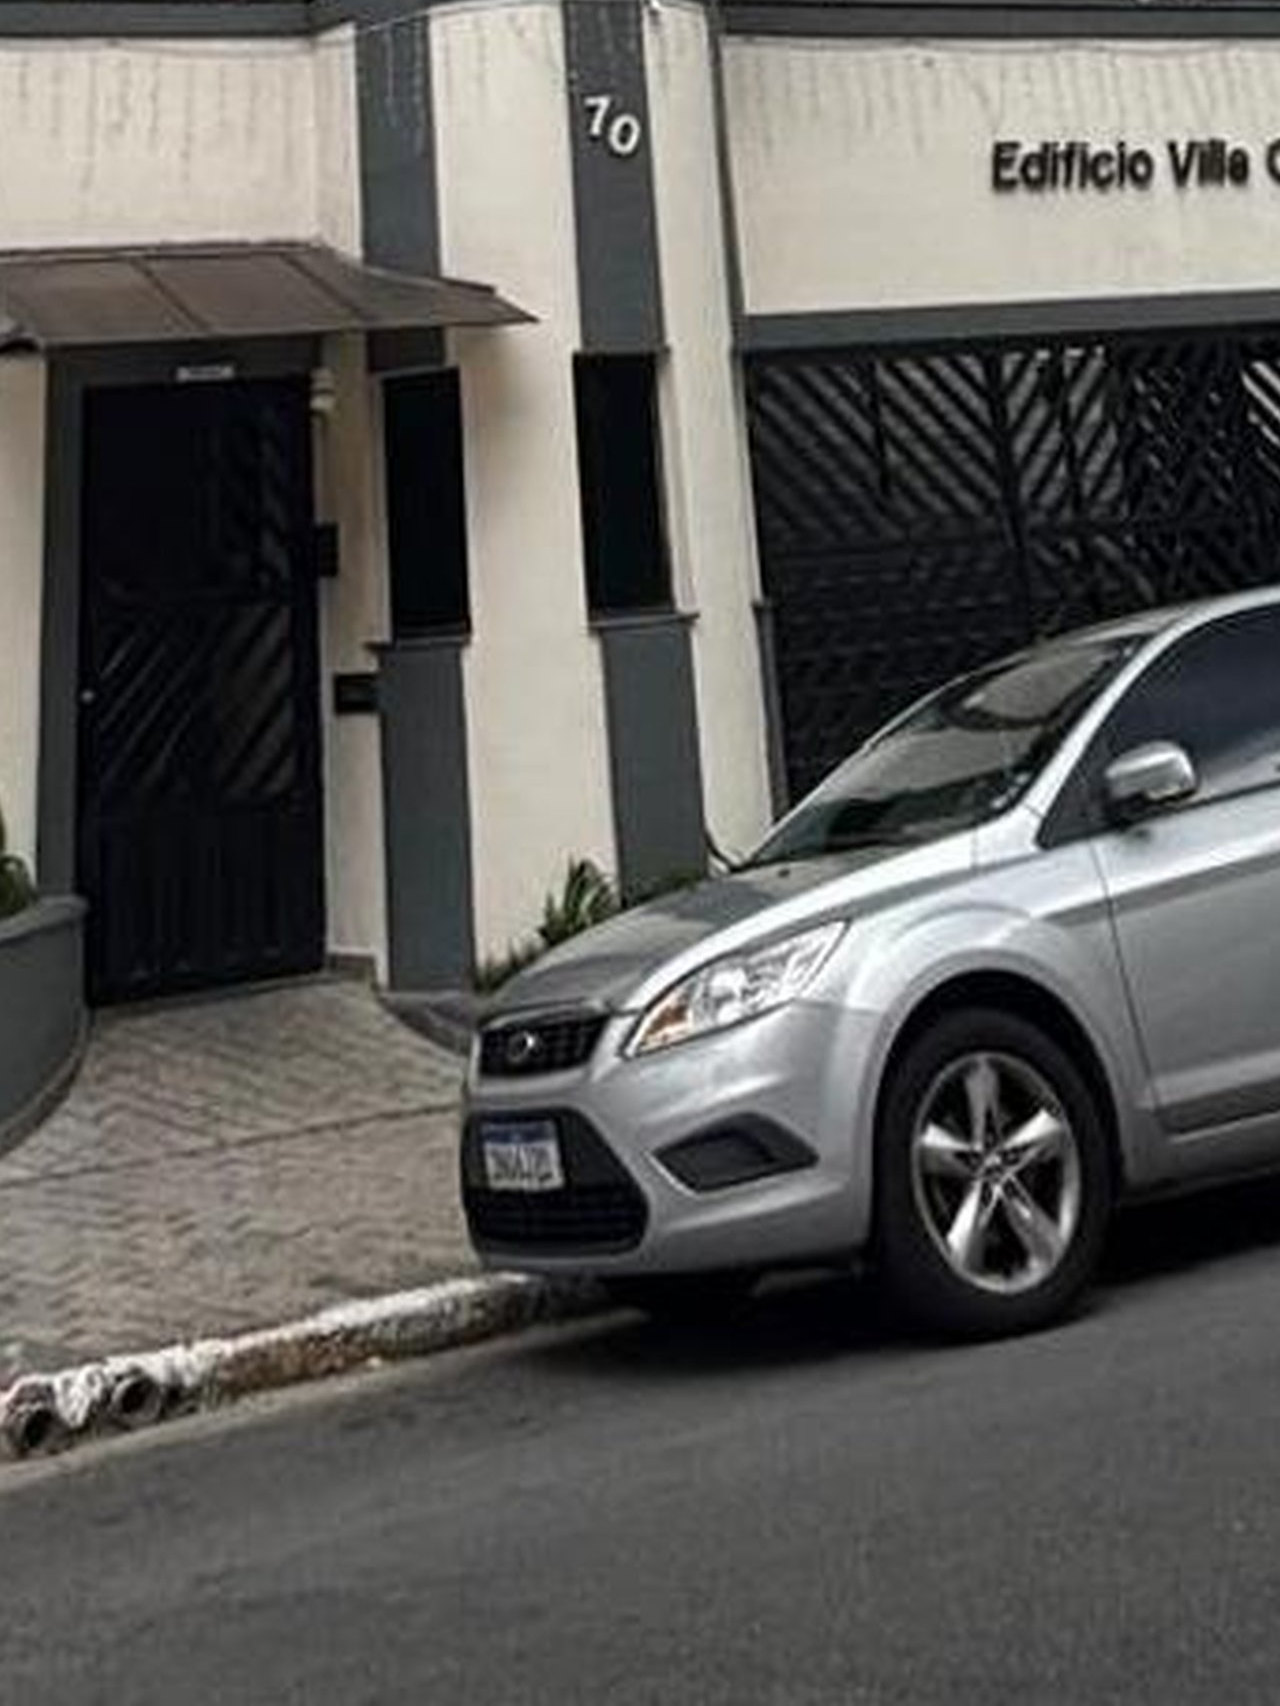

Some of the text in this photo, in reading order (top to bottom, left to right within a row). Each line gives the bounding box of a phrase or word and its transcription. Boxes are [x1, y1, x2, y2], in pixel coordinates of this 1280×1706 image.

[583, 94, 640, 154] 70
[992, 140, 1154, 191] Edificio
[1167, 138, 1249, 189] Villa
